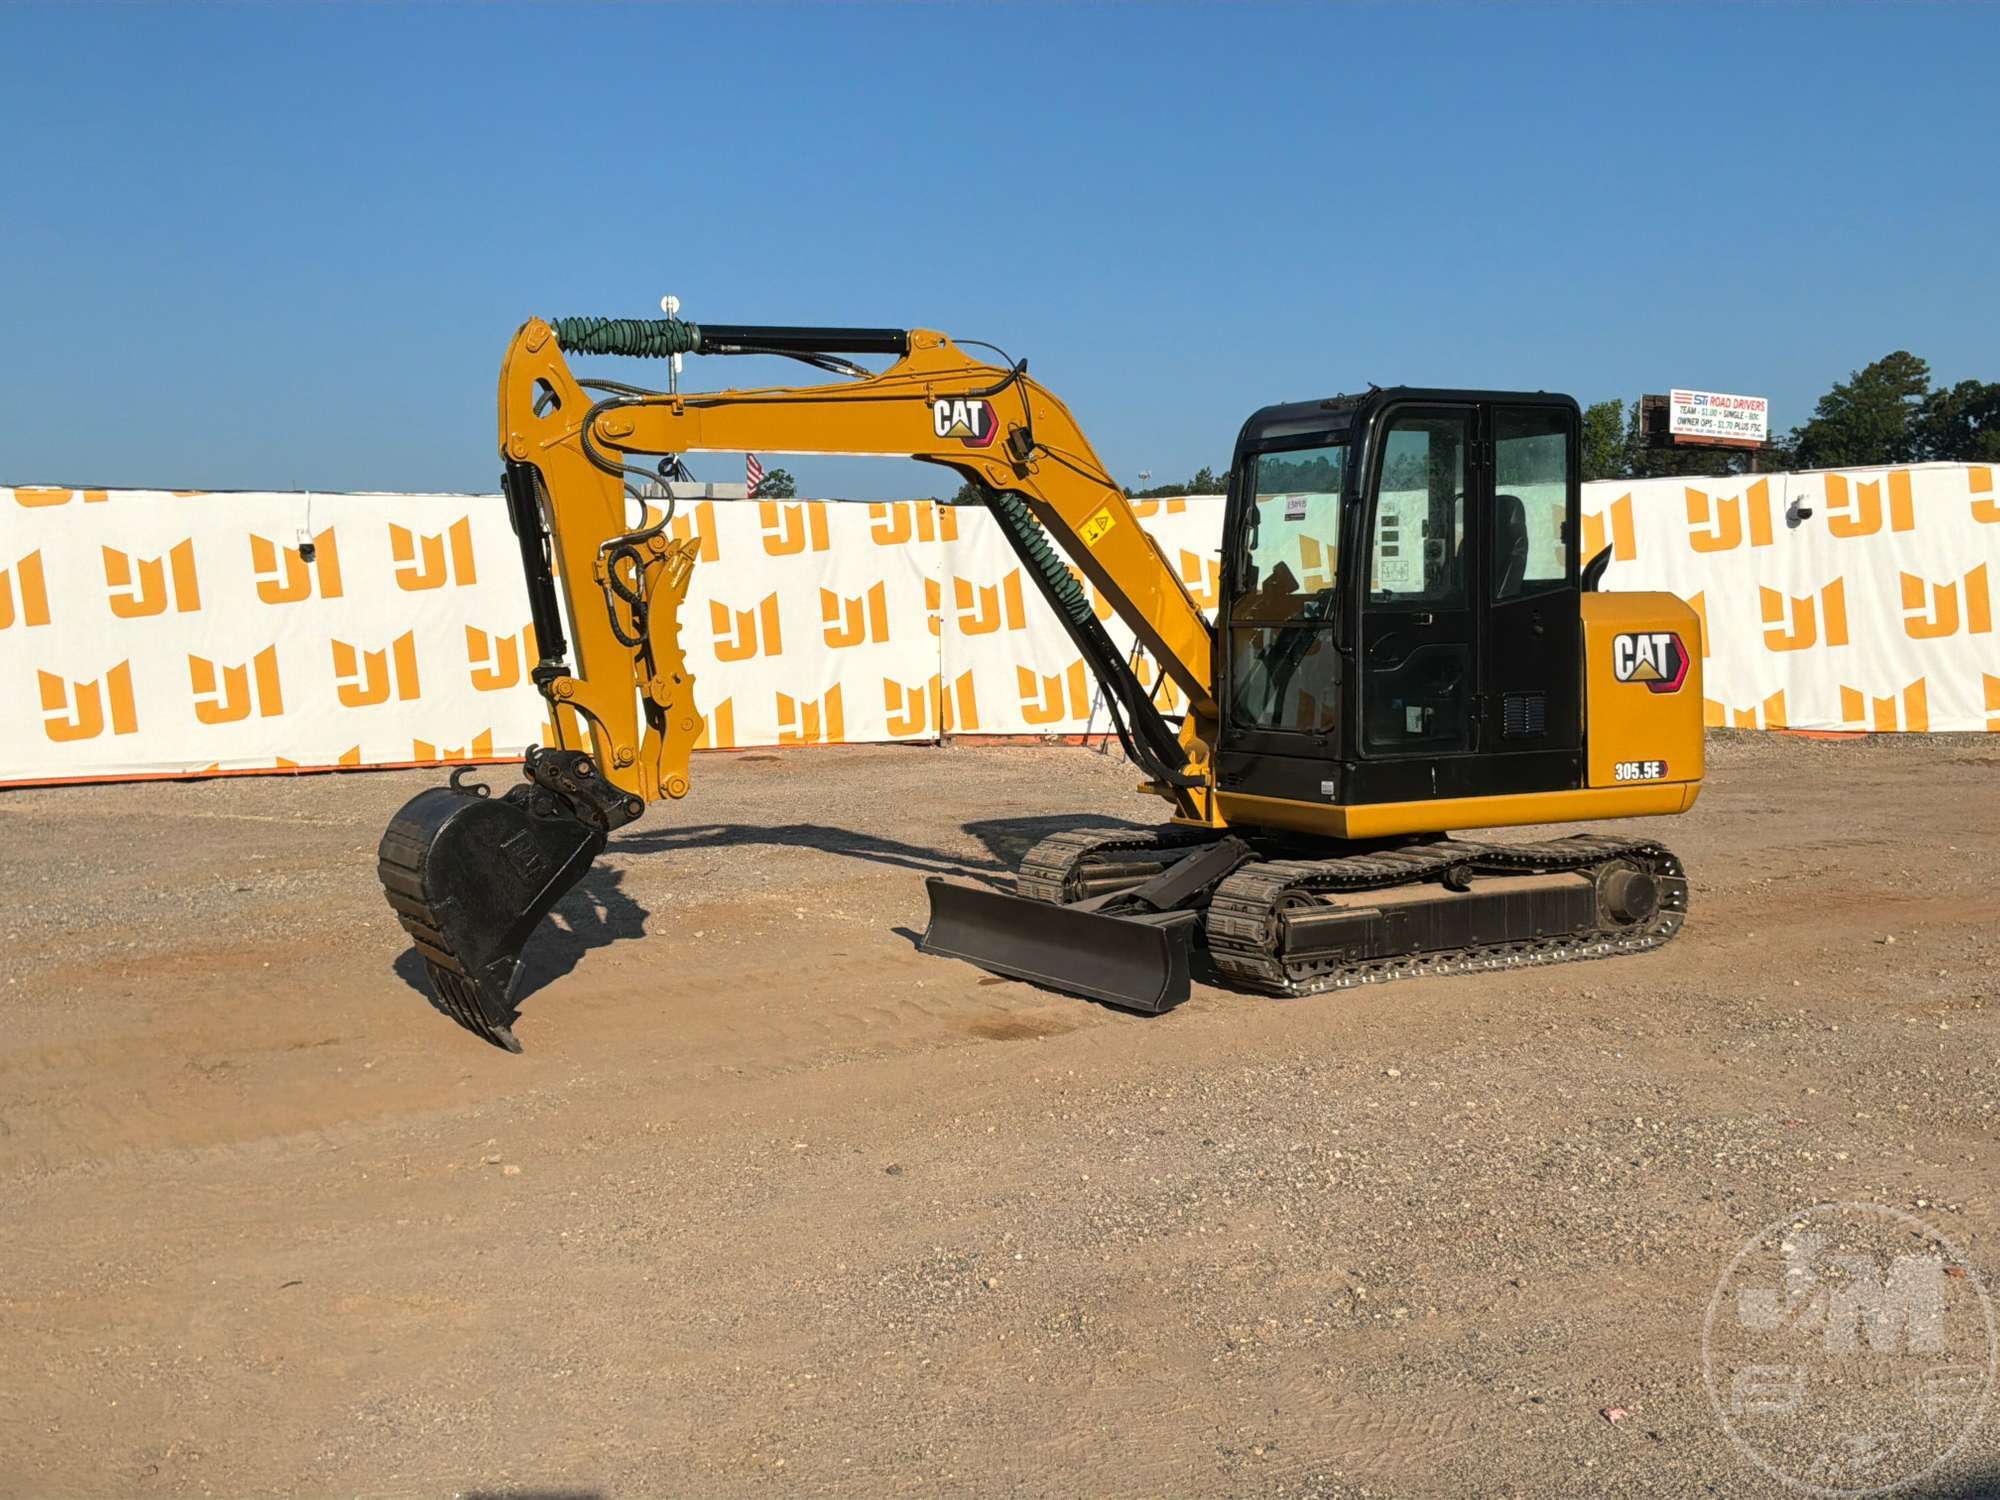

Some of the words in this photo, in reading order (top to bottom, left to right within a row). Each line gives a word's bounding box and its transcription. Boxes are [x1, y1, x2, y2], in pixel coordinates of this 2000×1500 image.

[1710, 396, 1731, 409] ROAD
[1733, 398, 1765, 411] DRIVERS
[934, 400, 982, 437] CAT
[1680, 406, 1696, 415] TEAM
[1723, 409, 1744, 420] SINGLE
[1677, 417, 1699, 426] OWNER
[1701, 418, 1713, 428] OPS
[1734, 422, 1749, 431] PLUS
[1614, 634, 1670, 681] CAT
[1615, 761, 1660, 780] 305.5E
